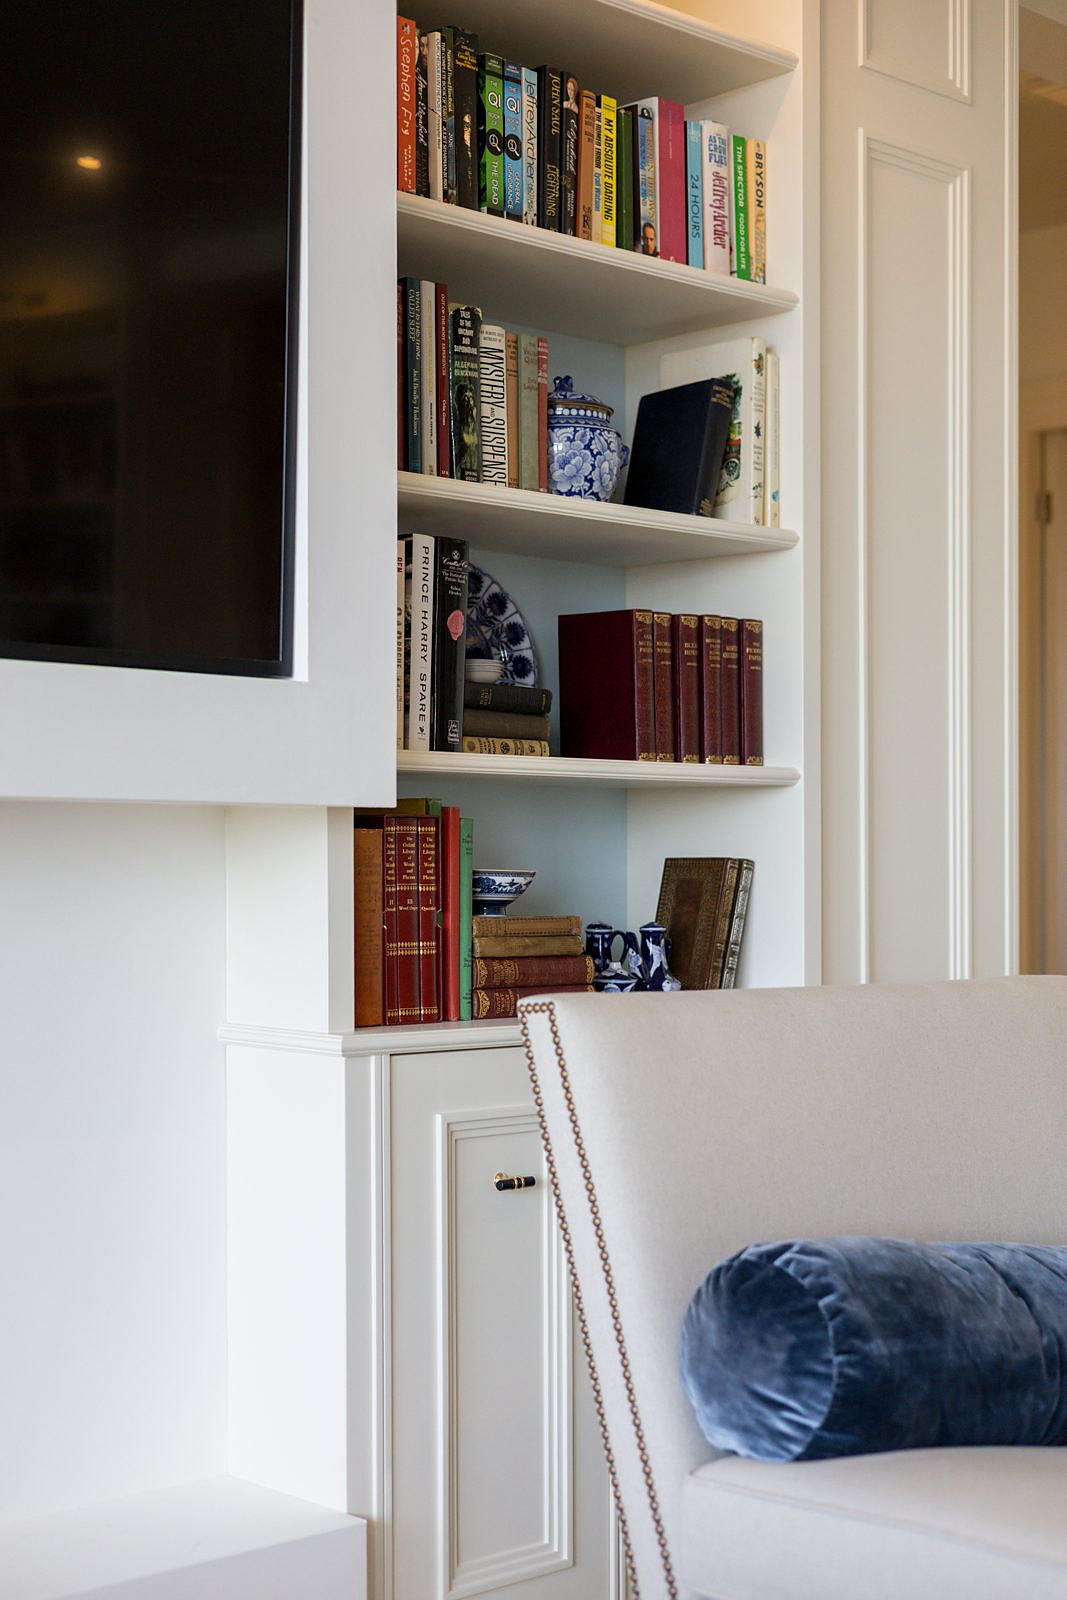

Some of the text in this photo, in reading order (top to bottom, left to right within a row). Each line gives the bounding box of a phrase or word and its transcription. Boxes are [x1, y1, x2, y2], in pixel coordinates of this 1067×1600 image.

[400, 36, 412, 136] Stephen Fry
[414, 67, 426, 147] After Elizabeth
[442, 96, 446, 104] OF
[549, 72, 560, 136] JOHN SAUL
[566, 120, 576, 176] Elizabeth
[604, 118, 614, 222] MY ABSOLUTE DARLING
[546, 164, 558, 217] LIGHTNING
[690, 174, 700, 239] 24 HOURS
[736, 164, 744, 208] SPECTOR
[755, 152, 764, 208] BRYSON
[480, 346, 505, 409] MYSTERY
[480, 416, 506, 487] SUSPENSE
[420, 610, 428, 663] HARRY
[418, 672, 426, 722] SPARE
